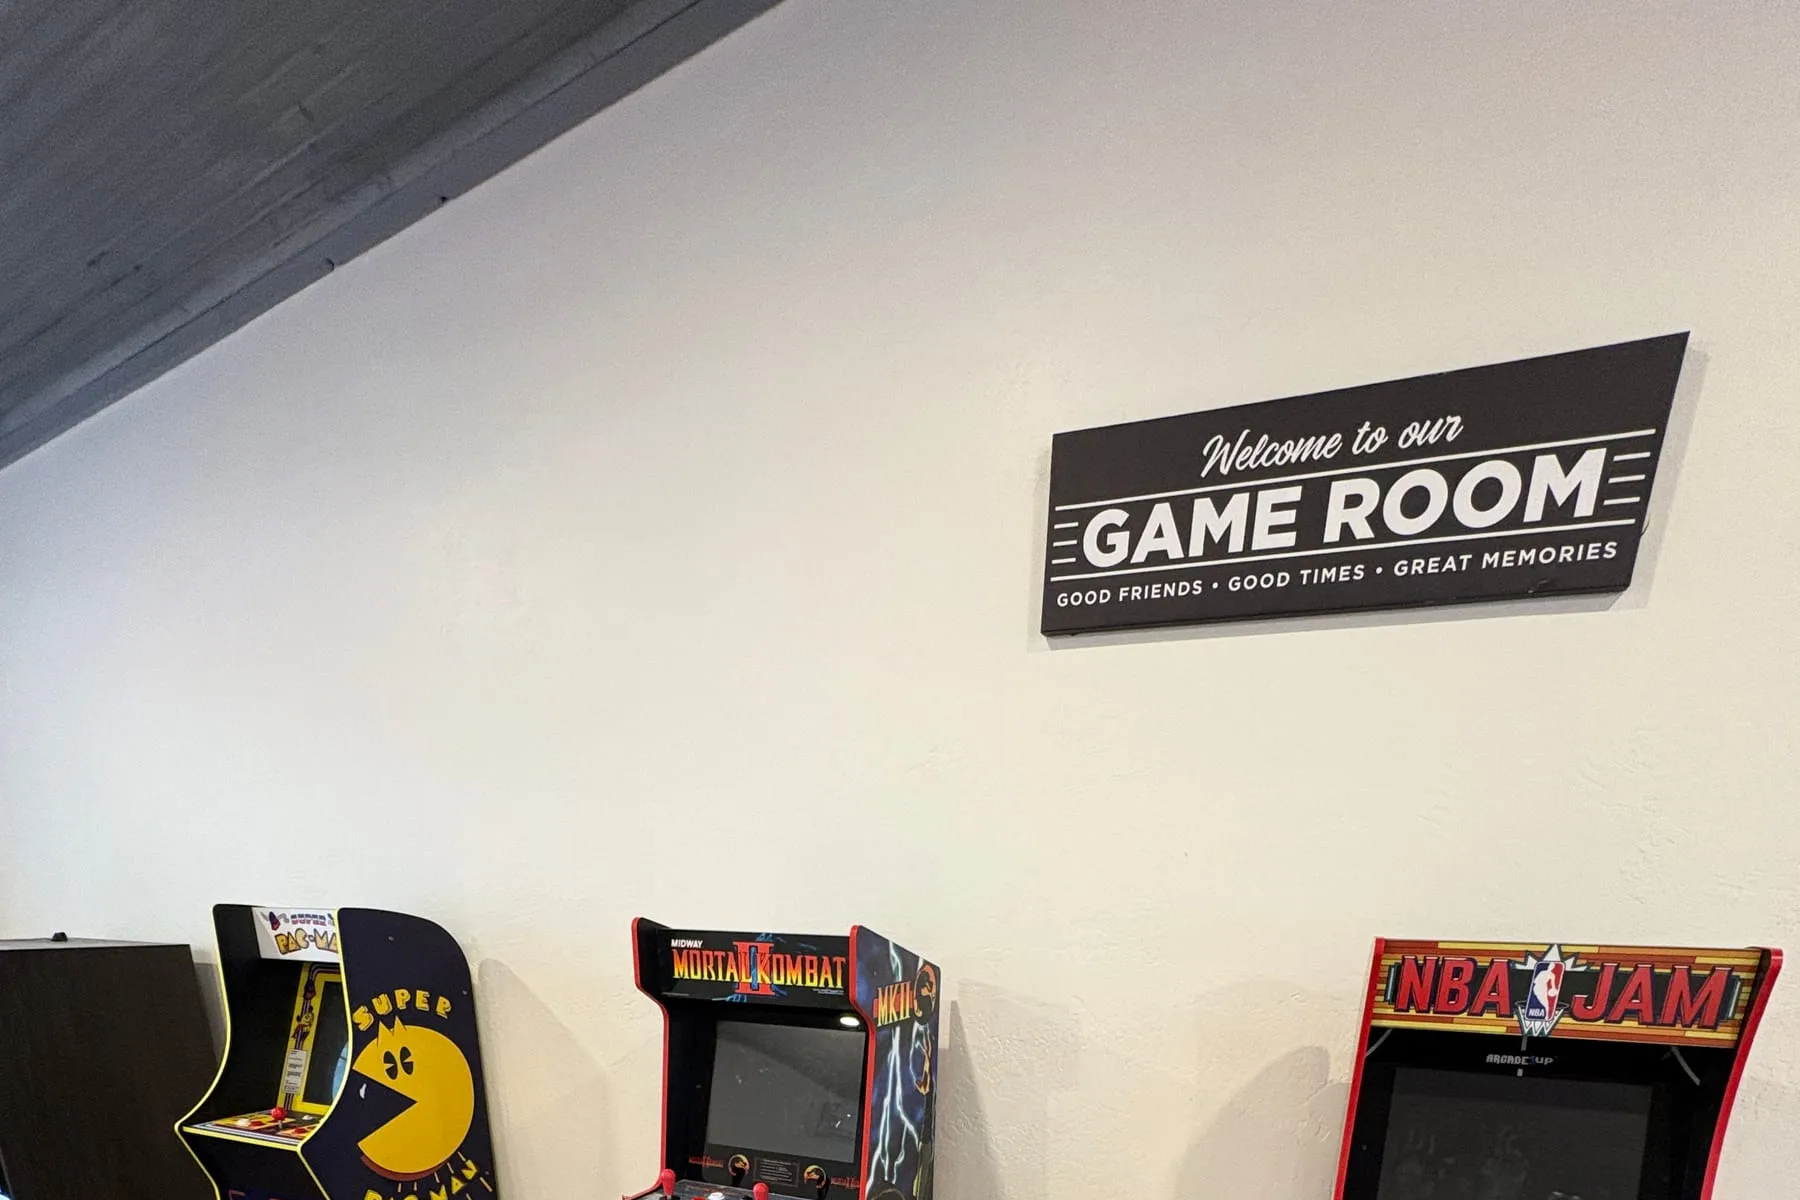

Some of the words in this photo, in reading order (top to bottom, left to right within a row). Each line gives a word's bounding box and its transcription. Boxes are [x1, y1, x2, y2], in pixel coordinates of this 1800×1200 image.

[1200, 429, 1342, 477] Welcome
[1352, 422, 1388, 455] to
[1398, 414, 1463, 447] our
[1082, 485, 1303, 567] GAME
[1323, 448, 1607, 544] ROOM
[1056, 588, 1111, 607] GOOD
[1118, 579, 1203, 602] FRIENDS
[1228, 571, 1291, 593] GOOD
[1300, 564, 1365, 585] TIMES
[1394, 553, 1470, 578] GREAT
[1481, 541, 1618, 569] MEMORIES
[275, 928, 338, 955] PAC-MA
[671, 939, 703, 948] MIDWAY
[672, 949, 752, 983] MORTAL
[756, 951, 846, 989] KOMBAT
[352, 988, 452, 1032] SUPER
[877, 981, 912, 1028] MKII
[1394, 955, 1514, 1017] NBA
[1568, 961, 1733, 1029] JAM
[1528, 1008, 1545, 1017] NBA
